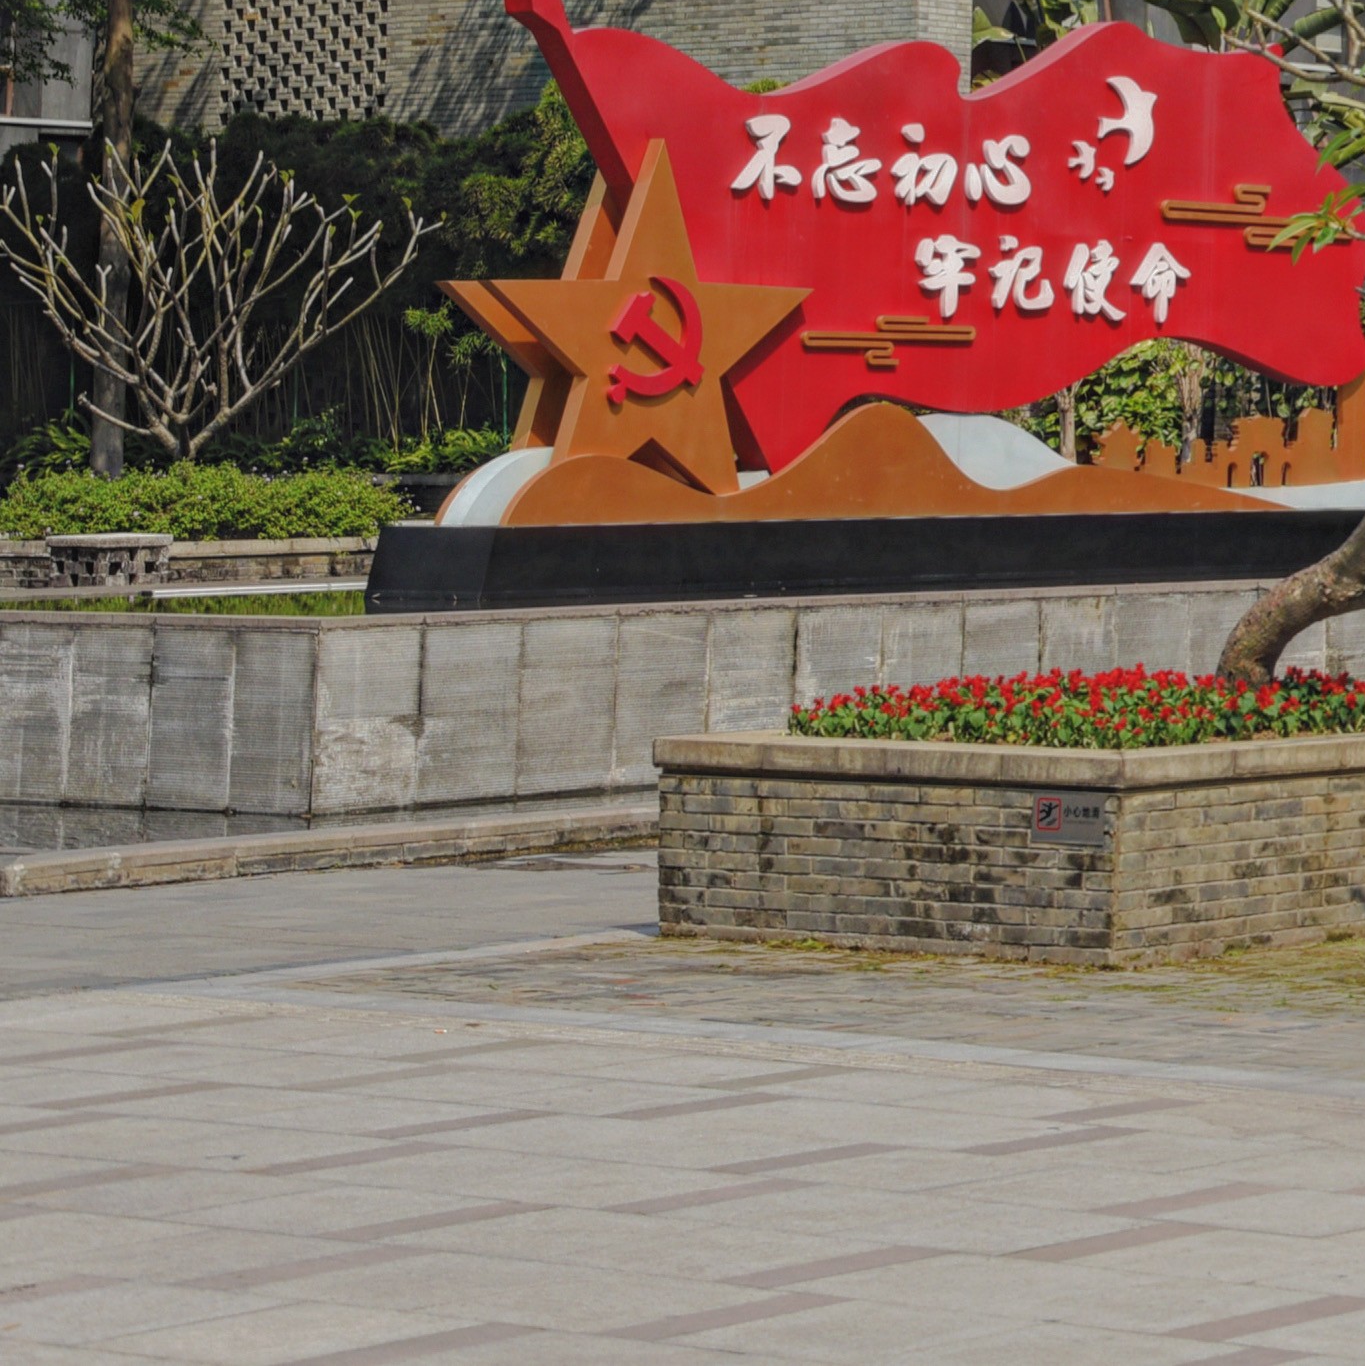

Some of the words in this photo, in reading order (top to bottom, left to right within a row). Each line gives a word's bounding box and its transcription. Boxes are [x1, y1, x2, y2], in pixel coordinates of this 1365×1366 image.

[730, 114, 1032, 208] 不忘初心
[913, 235, 1192, 324] 牢记使命
